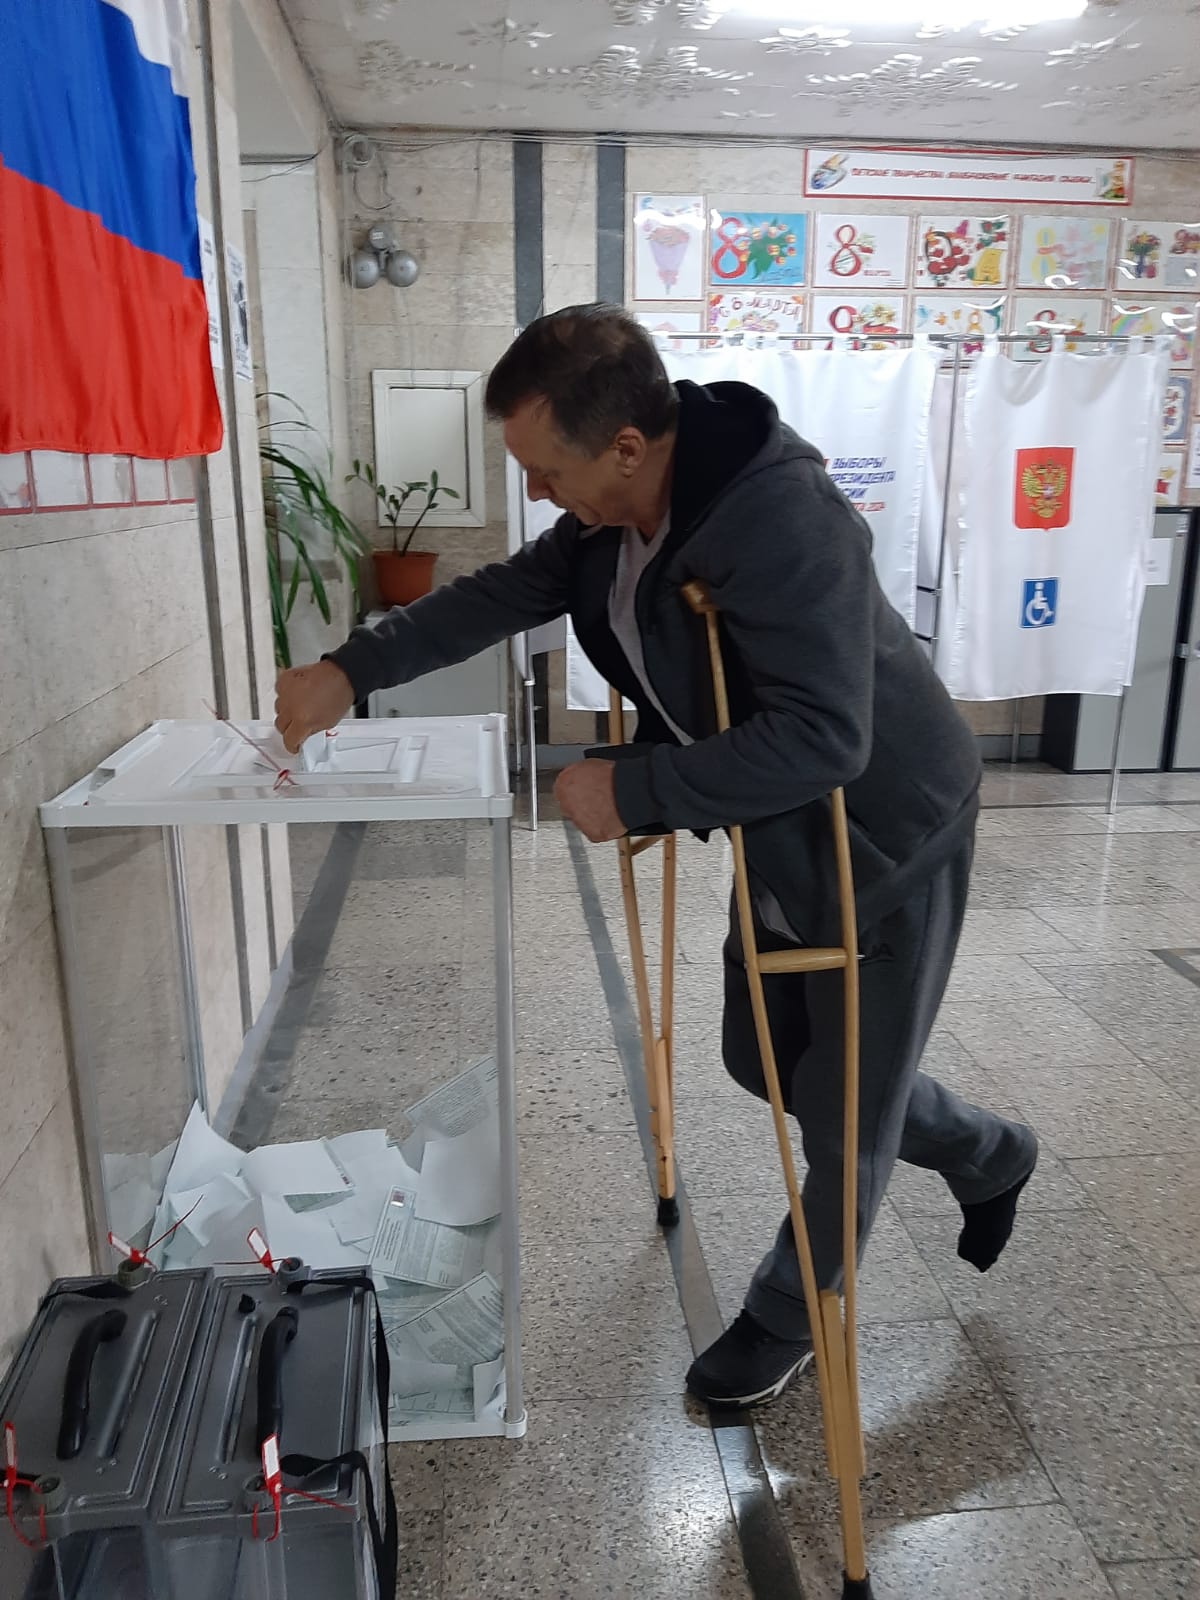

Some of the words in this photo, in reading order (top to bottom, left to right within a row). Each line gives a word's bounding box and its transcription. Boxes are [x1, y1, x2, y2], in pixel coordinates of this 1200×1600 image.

[831, 224, 862, 277] 8
[831, 456, 887, 468] ВЫБОРЫ
[829, 471, 896, 483] РЕЗИДЕНТА
